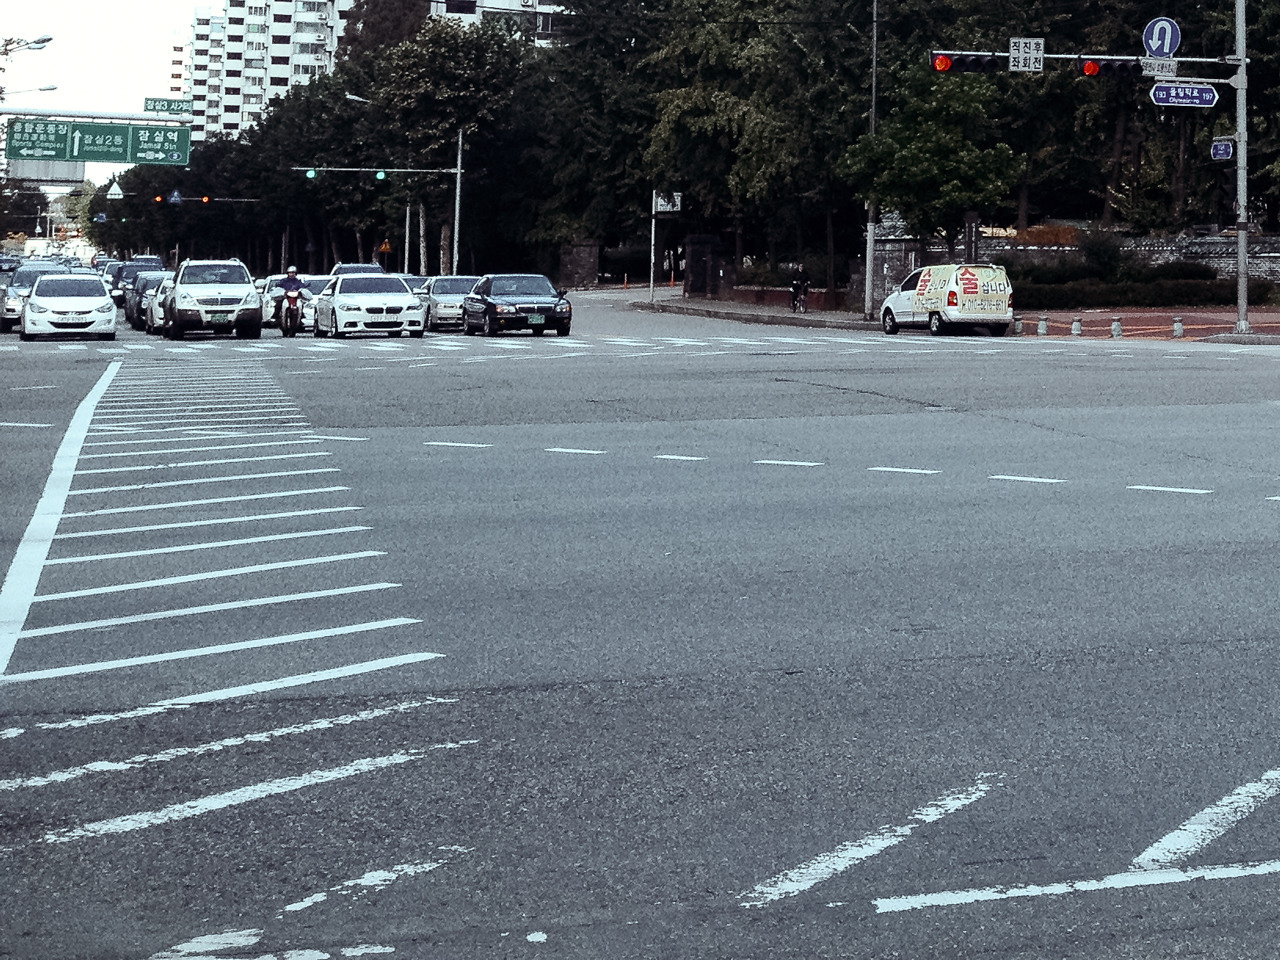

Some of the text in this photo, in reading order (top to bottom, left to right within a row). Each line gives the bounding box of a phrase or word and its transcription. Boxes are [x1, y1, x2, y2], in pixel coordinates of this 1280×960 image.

[1011, 41, 1042, 54] 직진후
[1011, 56, 1042, 69] 좌회전
[138, 130, 179, 143] 잠실역
[959, 267, 979, 295] 술
[982, 281, 1007, 294] 삽니다
